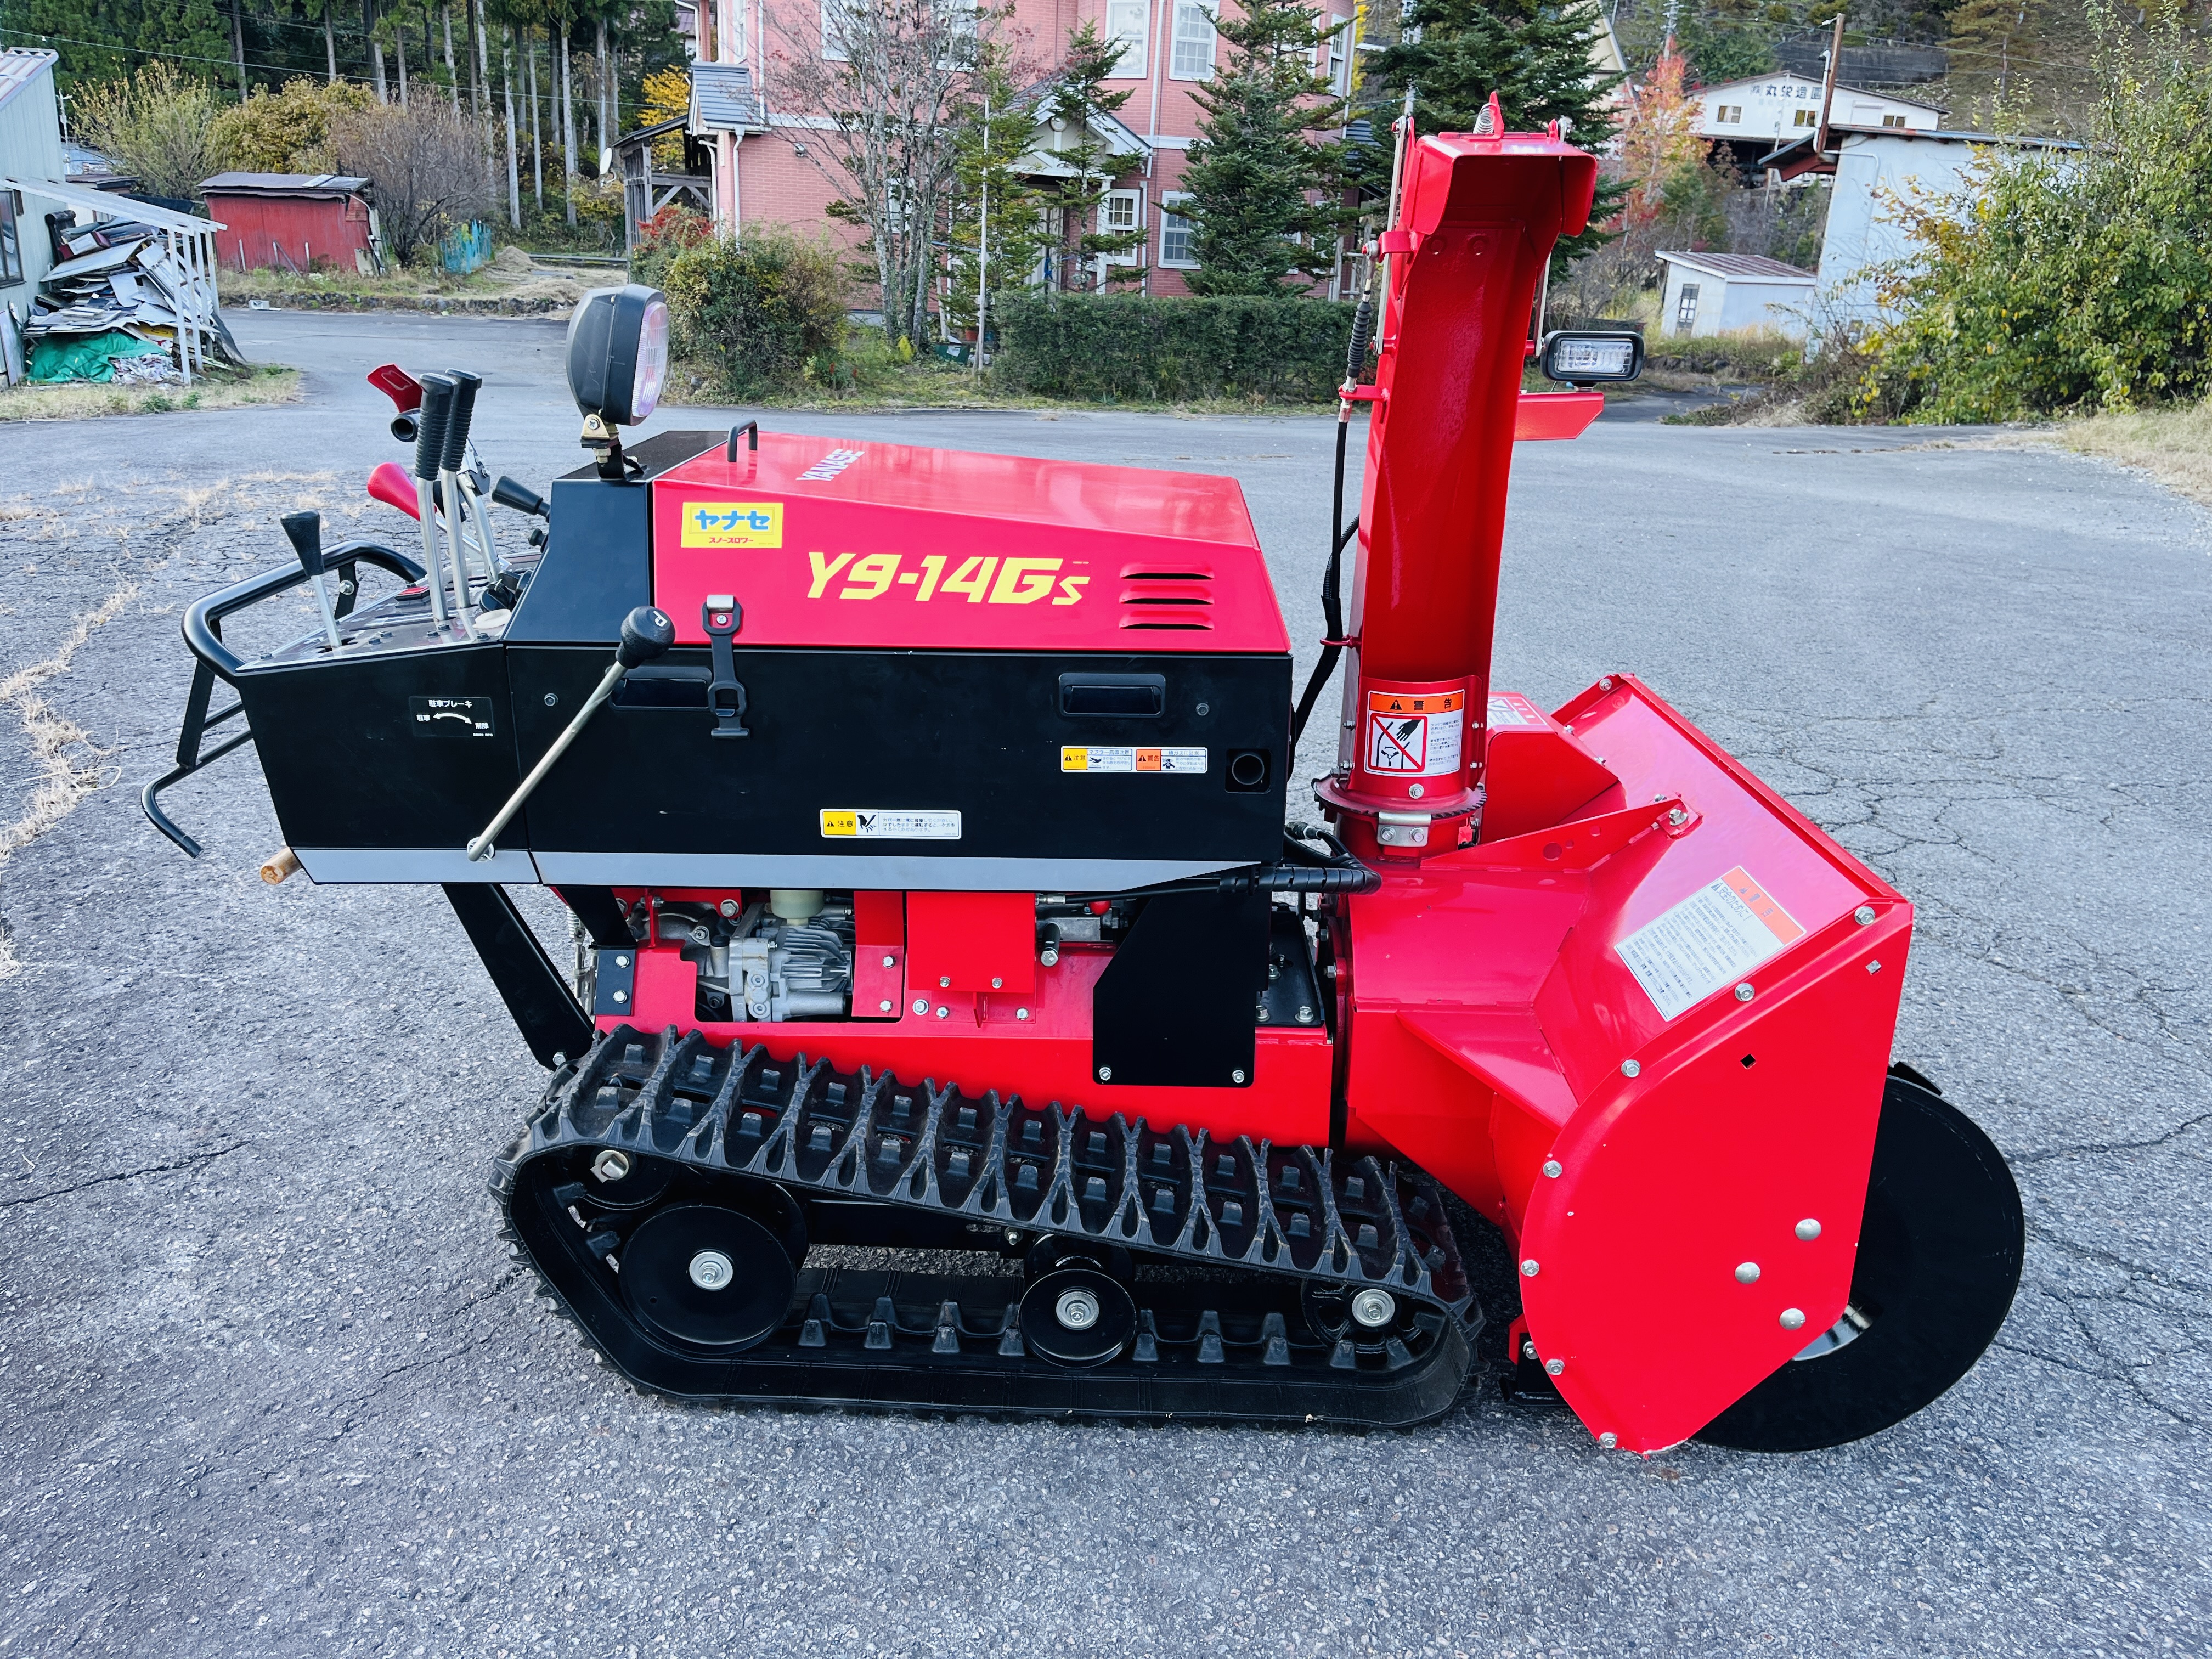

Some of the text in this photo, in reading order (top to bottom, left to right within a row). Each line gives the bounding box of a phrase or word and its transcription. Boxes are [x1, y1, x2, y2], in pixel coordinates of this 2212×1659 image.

[795, 449, 865, 481] YANASE
[695, 510, 770, 531] ヤナセ
[428, 699, 472, 708] 駐車ブレーキ
